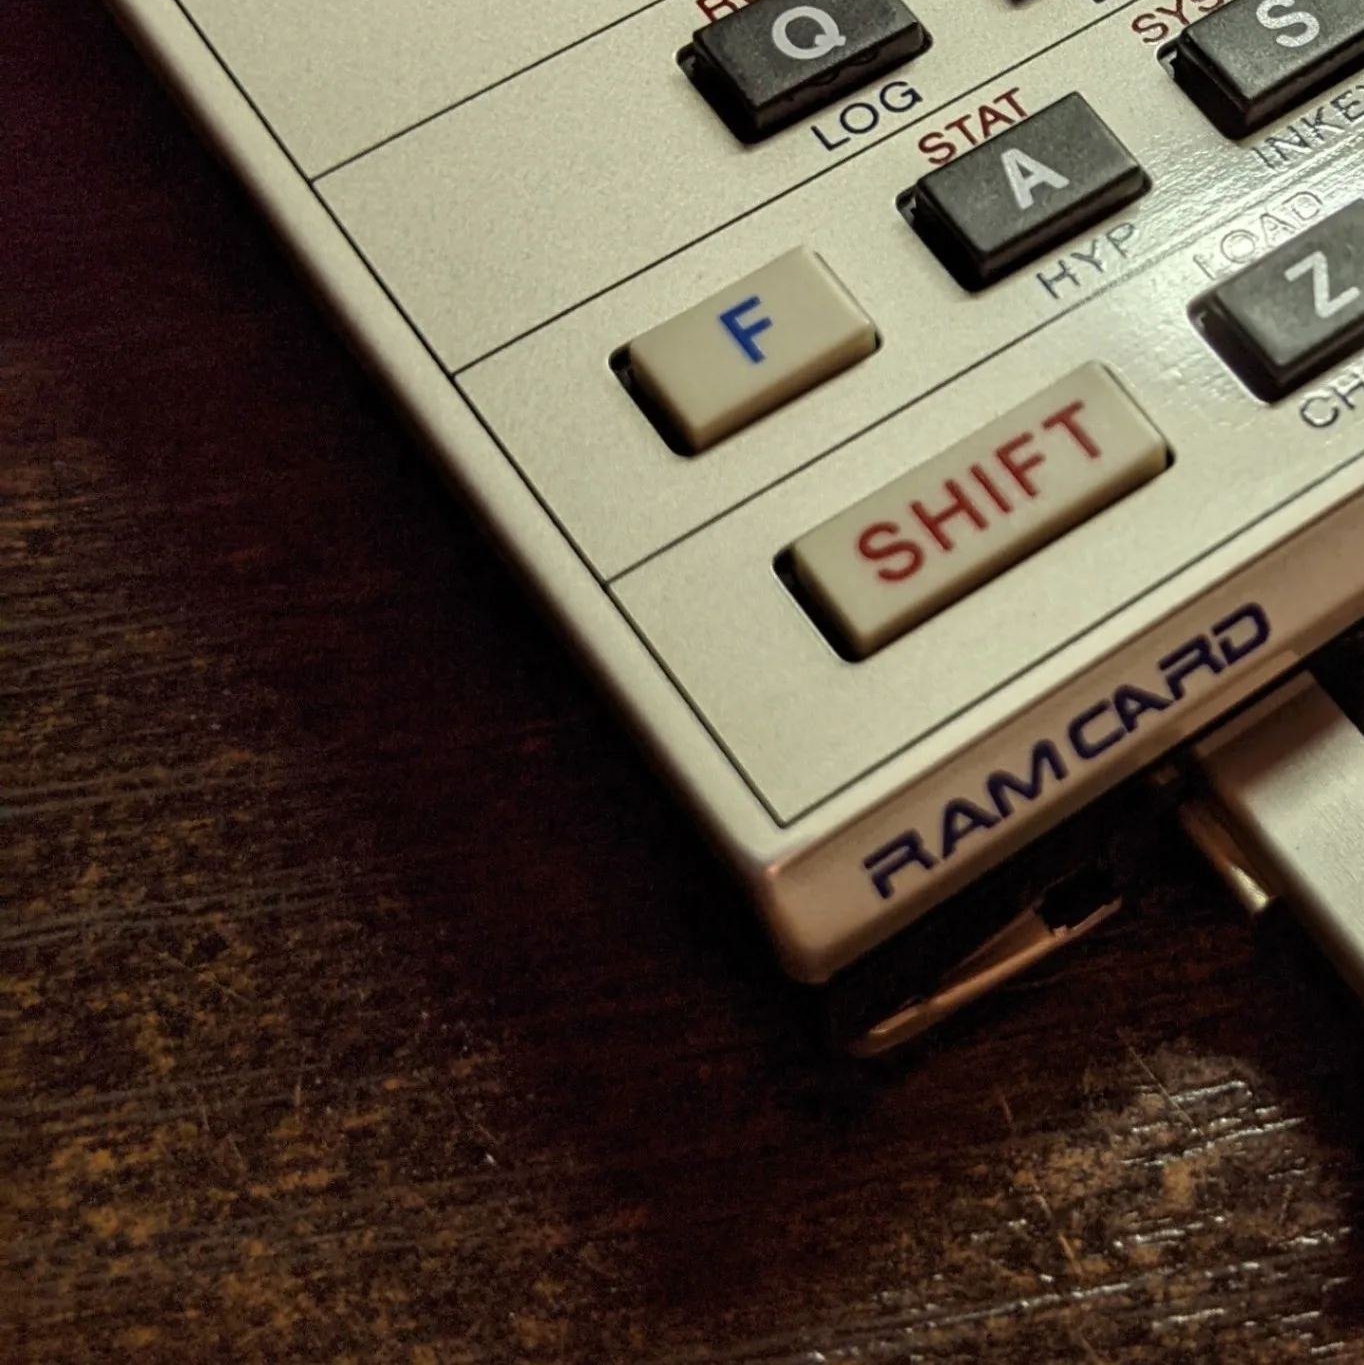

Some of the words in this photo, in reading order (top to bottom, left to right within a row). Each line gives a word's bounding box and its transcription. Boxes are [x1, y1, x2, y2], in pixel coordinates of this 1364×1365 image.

[772, 5, 848, 59] Q
[809, 80, 924, 151] LOG
[917, 87, 1030, 166] STAT
[1000, 148, 1070, 209] A
[1036, 221, 1141, 300] HYP
[1191, 188, 1326, 283] LOAD
[1284, 252, 1361, 321] Z
[716, 295, 775, 364] F
[857, 399, 1105, 583] SHIFT
